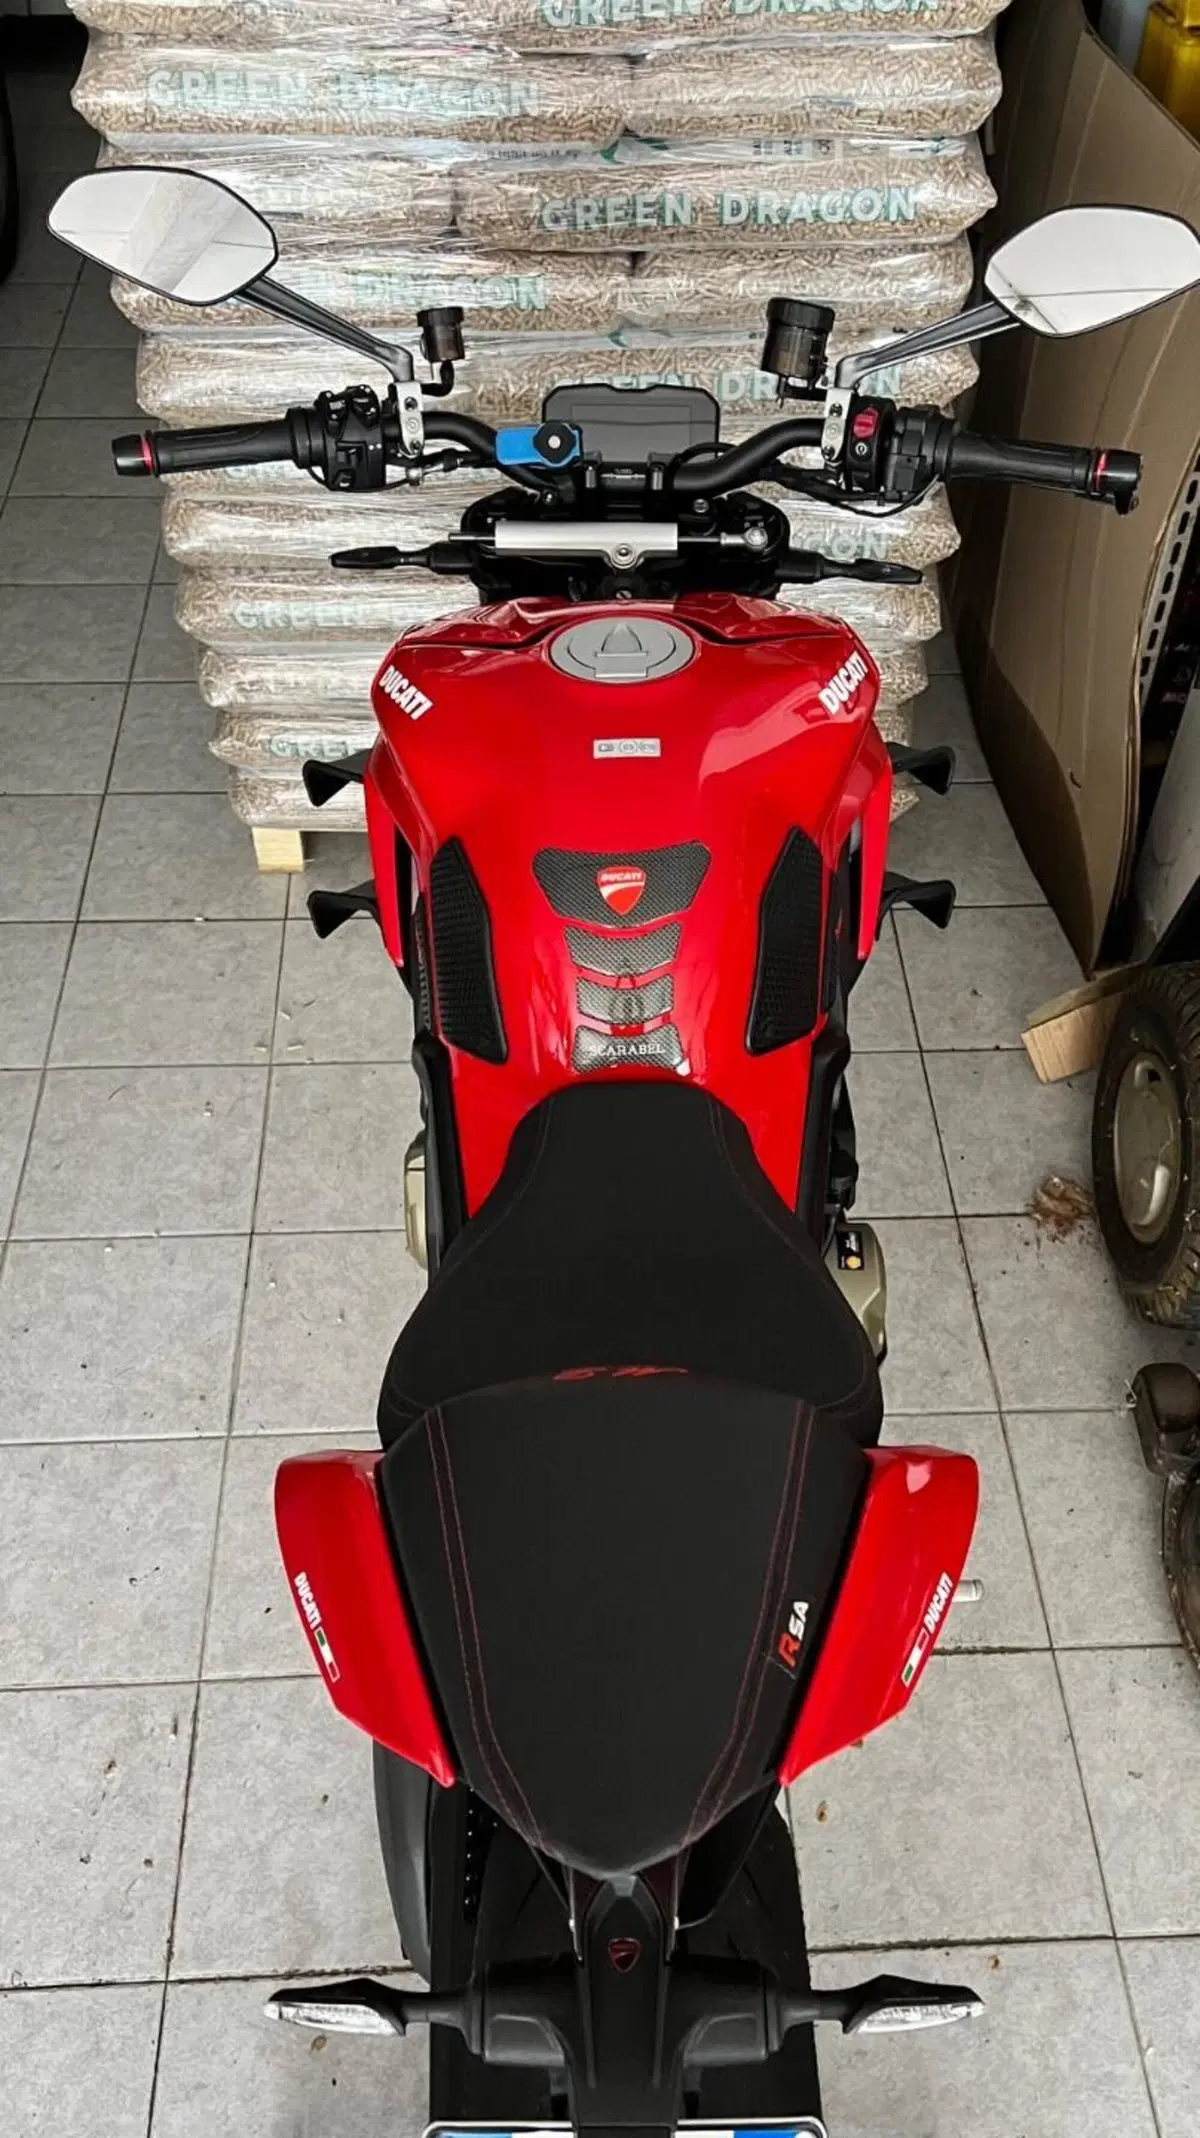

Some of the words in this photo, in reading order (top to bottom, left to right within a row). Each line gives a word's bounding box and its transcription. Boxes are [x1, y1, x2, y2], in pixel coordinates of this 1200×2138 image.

[147, 70, 307, 110] GREEN
[538, 193, 693, 231] GREEN
[719, 187, 918, 225] DRAGON
[233, 602, 362, 629] GREEN
[379, 665, 434, 720] DUCATI
[818, 651, 869, 715] DUCATI
[600, 871, 642, 882] DUCATI
[294, 1571, 322, 1630] DUCATI
[923, 1571, 954, 1634] DUCATI
[778, 1601, 810, 1668] RSA
